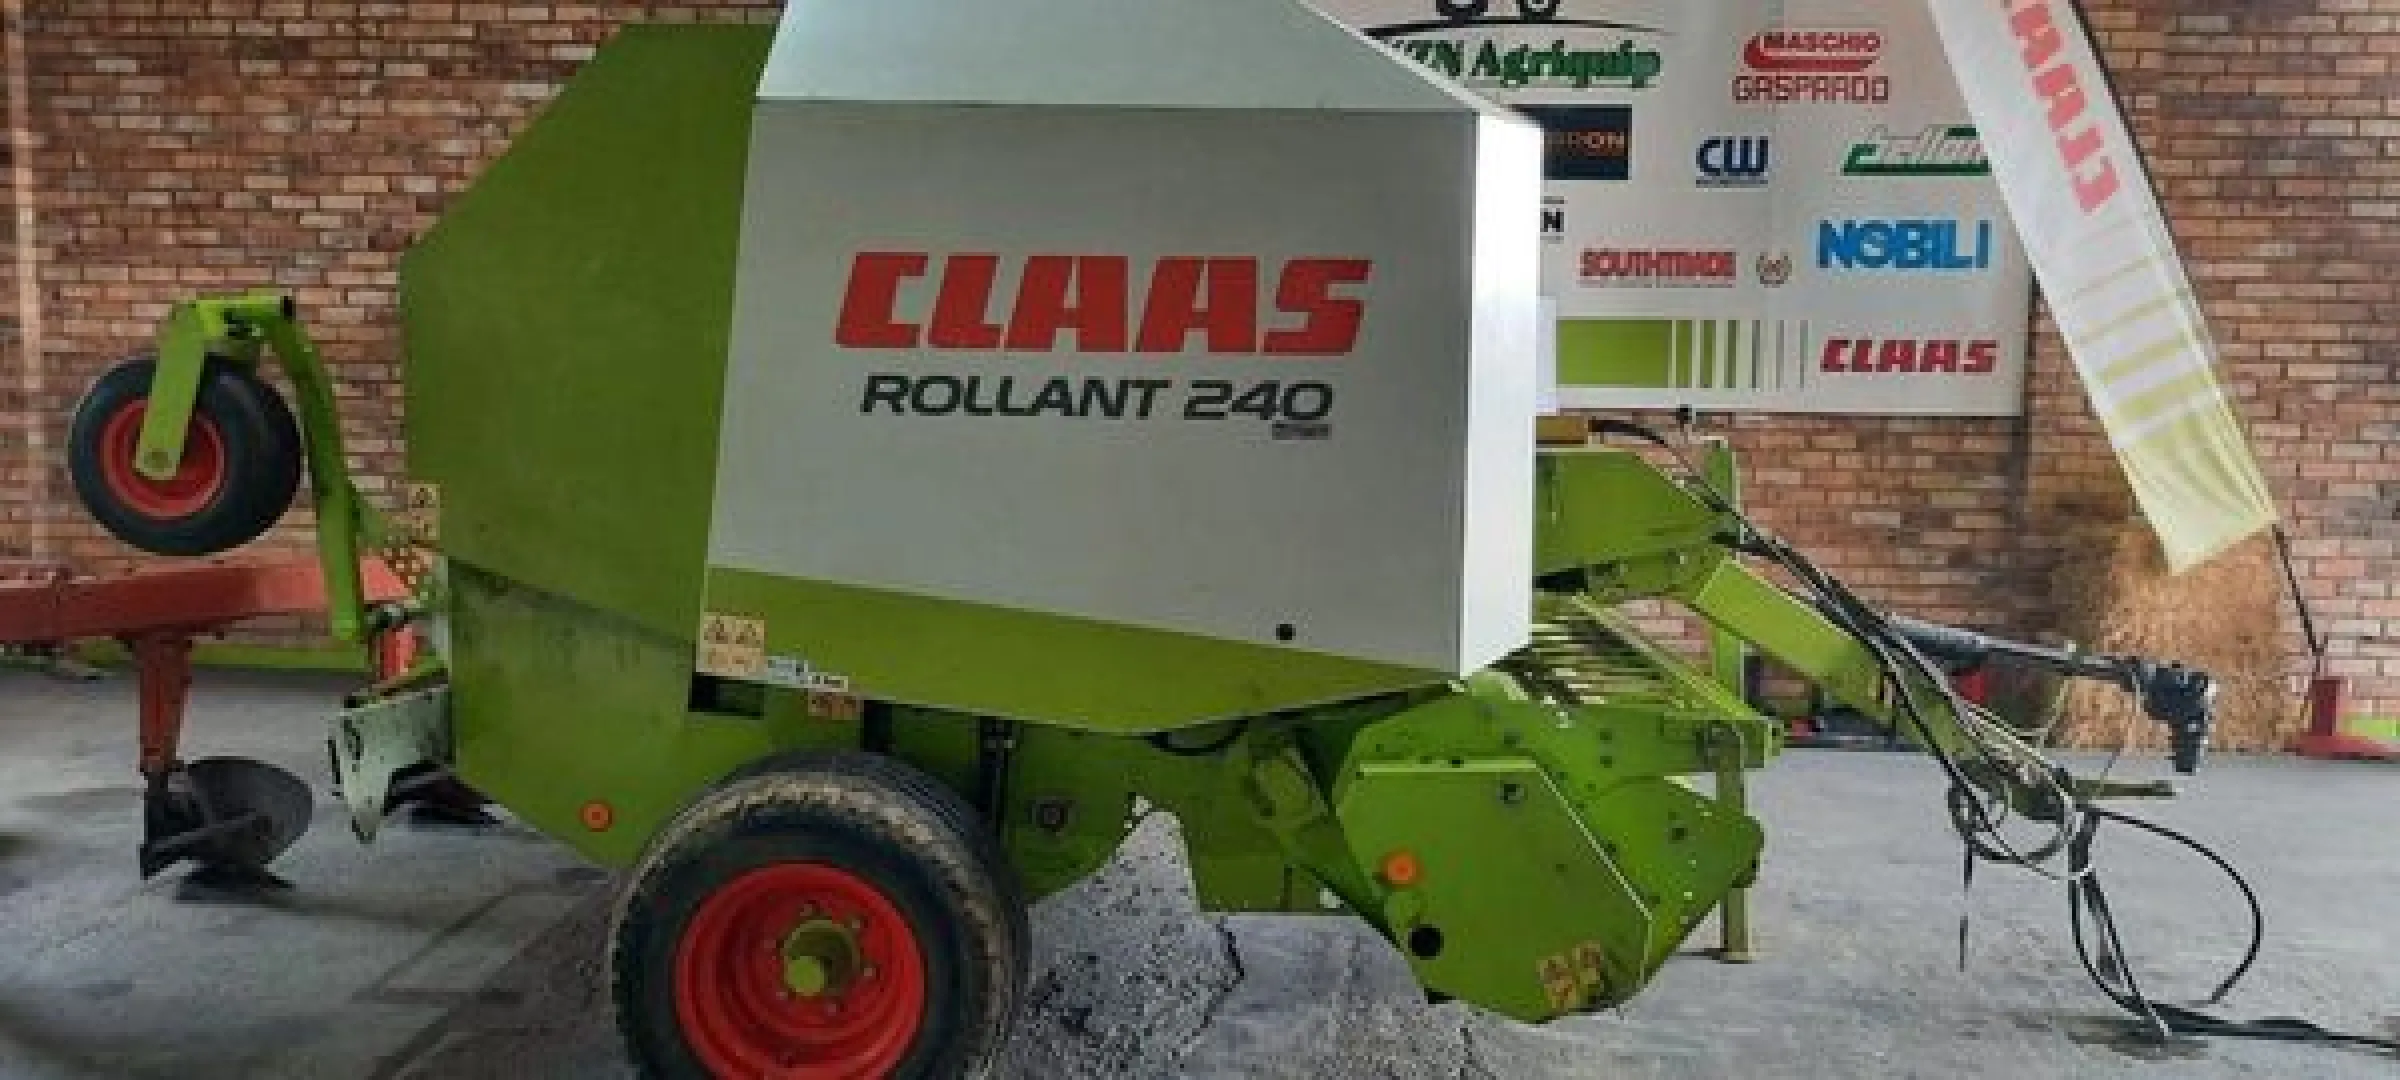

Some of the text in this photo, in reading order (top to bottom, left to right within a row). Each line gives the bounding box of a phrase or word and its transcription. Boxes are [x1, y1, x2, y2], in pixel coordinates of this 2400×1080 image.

[1392, 39, 1661, 88] ZN Agriquip
[1760, 31, 1881, 53] MASCHIO
[2002, 0, 2120, 214] CLAA
[1697, 136, 1769, 177] CW
[1817, 219, 1992, 269] NOBILI
[836, 252, 1373, 355] CLAAS
[1820, 339, 1997, 373] CLAAS
[860, 374, 1335, 421] ROLLANT 240
